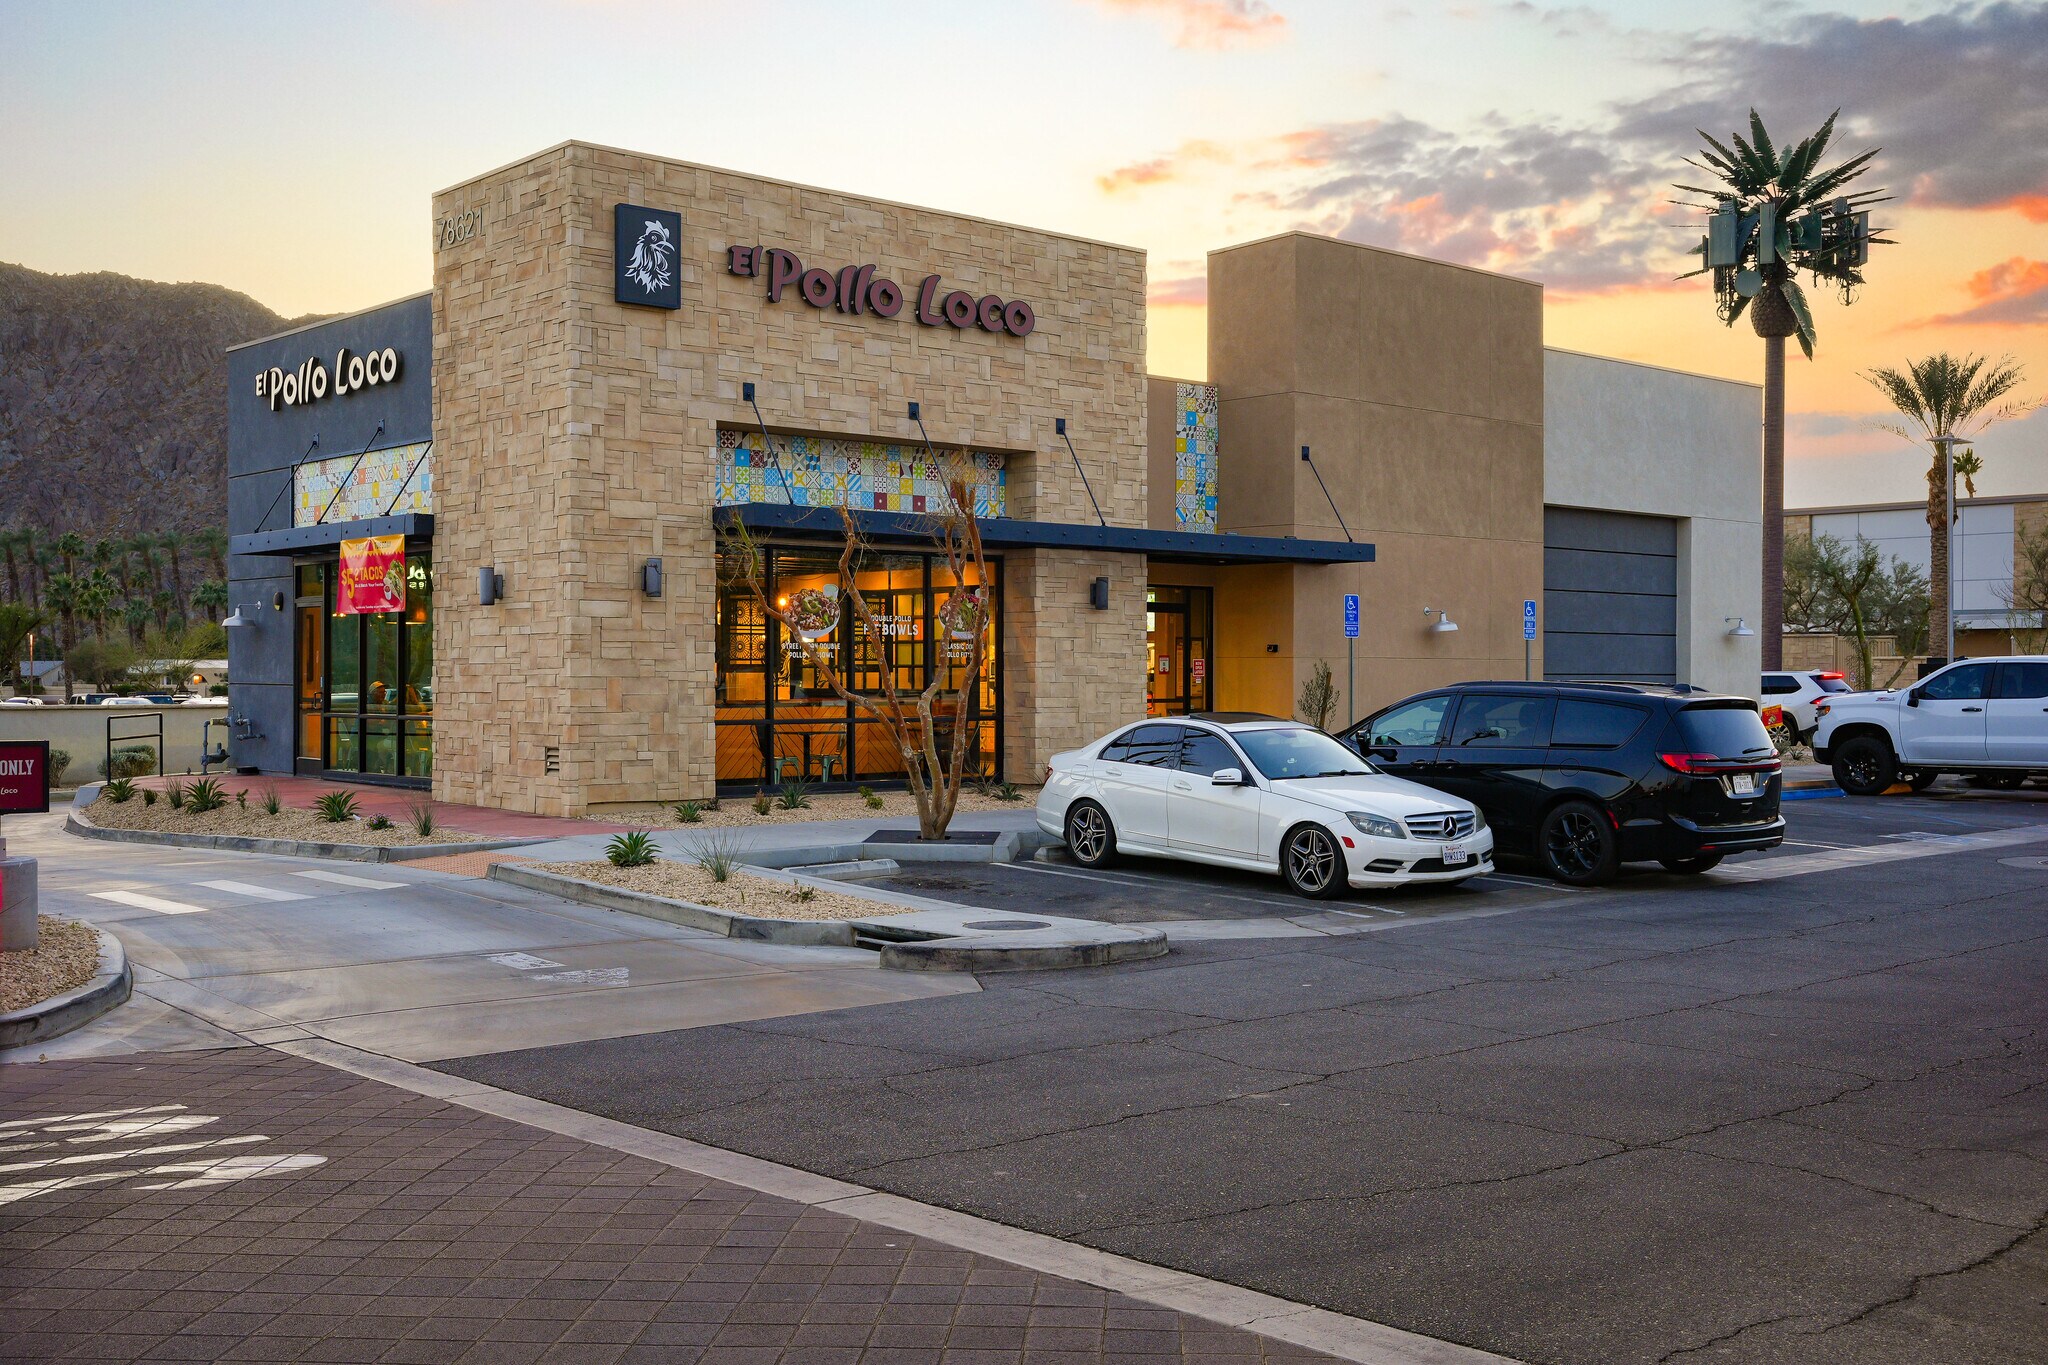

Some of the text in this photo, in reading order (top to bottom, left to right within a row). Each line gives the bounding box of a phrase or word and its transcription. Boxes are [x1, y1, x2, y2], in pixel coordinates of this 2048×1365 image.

[437, 207, 484, 250] 78621
[727, 245, 1035, 337] El Pollo Loco
[255, 347, 401, 412] El Pollo Loco
[354, 565, 384, 581] 2 TACOS
[341, 567, 355, 599] $5
[883, 624, 919, 636] BOWLS
[820, 642, 841, 650] DOUBLE
[789, 651, 807, 659] POLLO
[0, 759, 35, 776] ONLY
[0, 787, 19, 795] Loco
